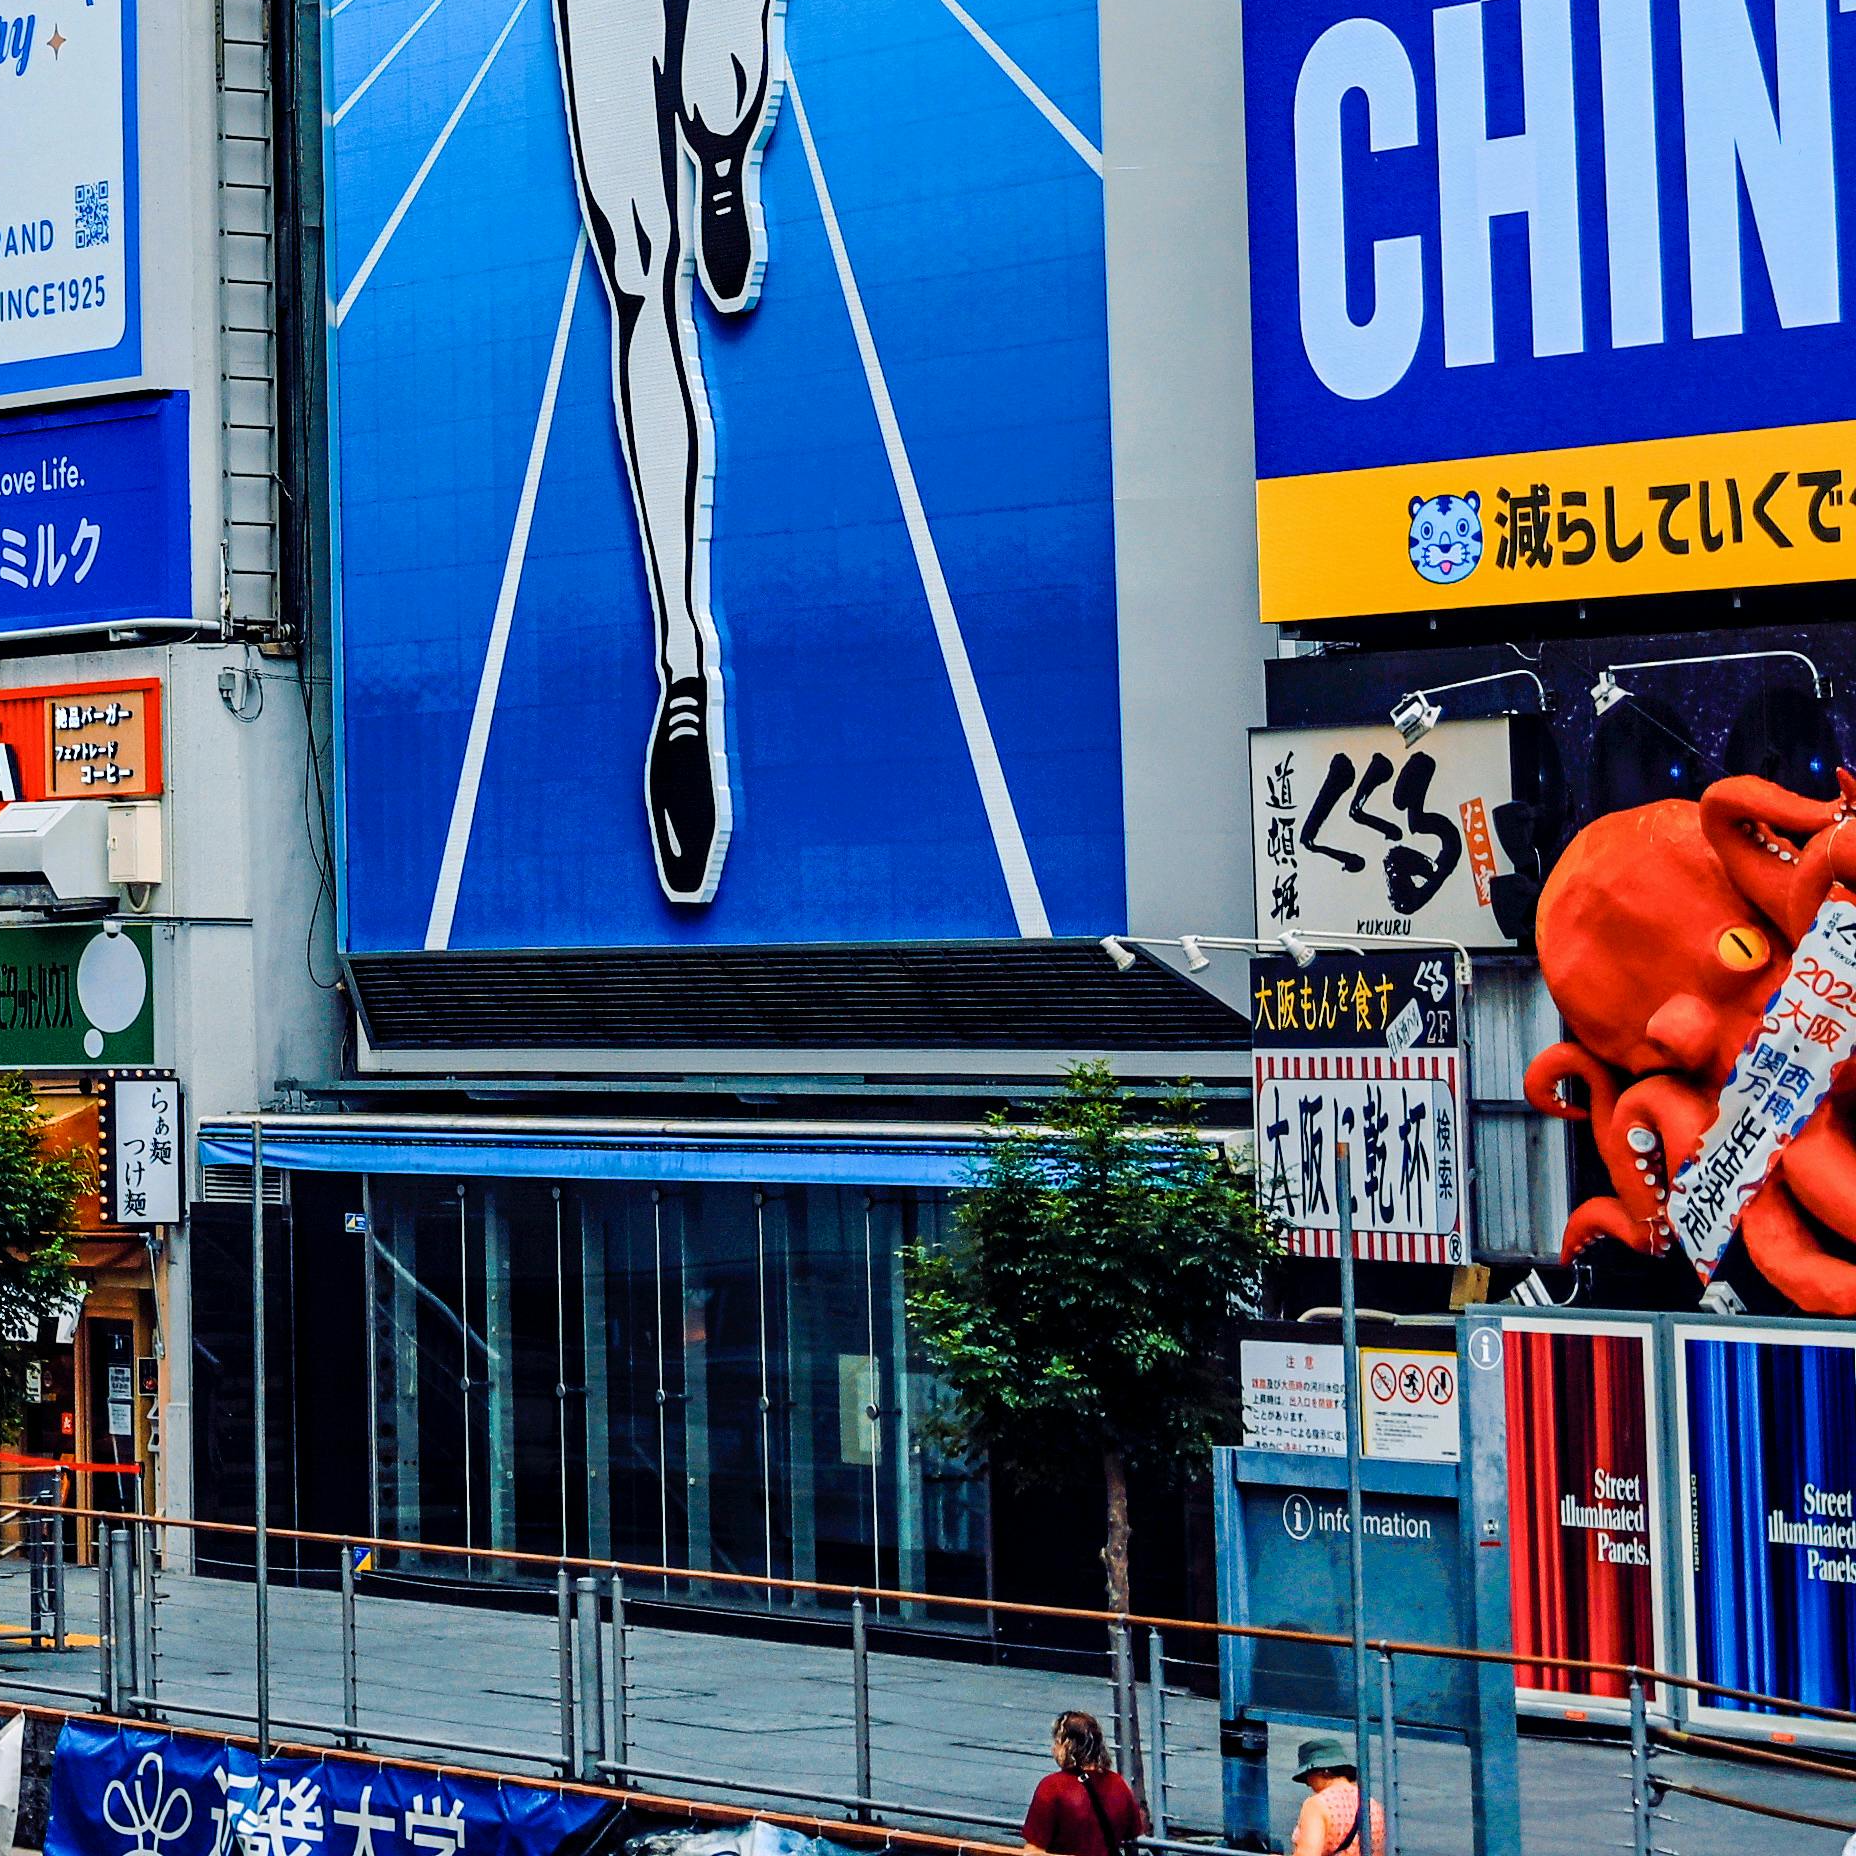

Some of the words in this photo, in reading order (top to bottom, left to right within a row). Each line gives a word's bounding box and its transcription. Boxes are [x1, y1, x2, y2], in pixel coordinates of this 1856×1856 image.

[44, 456, 85, 489] Life.
[55, 703, 132, 729] 絶品バーガー
[55, 741, 117, 761] フェアトレード
[81, 764, 133, 784] コーヒー
[1266, 751, 1299, 925] 道頓堀
[1300, 752, 1462, 915] くくる
[1357, 919, 1411, 935] KUKURU
[1414, 961, 1448, 1002] くくる
[1255, 971, 1394, 1032] 大阪もんを食す
[1427, 1010, 1451, 1044] 2F
[1778, 998, 1846, 1053] 大阪
[1752, 1043, 1815, 1100] 関西
[1738, 1072, 1795, 1126] 万博
[149, 1087, 171, 1166] らぁ麺
[1436, 1110, 1454, 1200] 検索
[123, 1137, 146, 1216] つけ麺
[1595, 1468, 1640, 1501] Street
[1804, 1483, 1853, 1517] Street
[1318, 1506, 1431, 1539] infomation
[1598, 1533, 1649, 1565] Panels.
